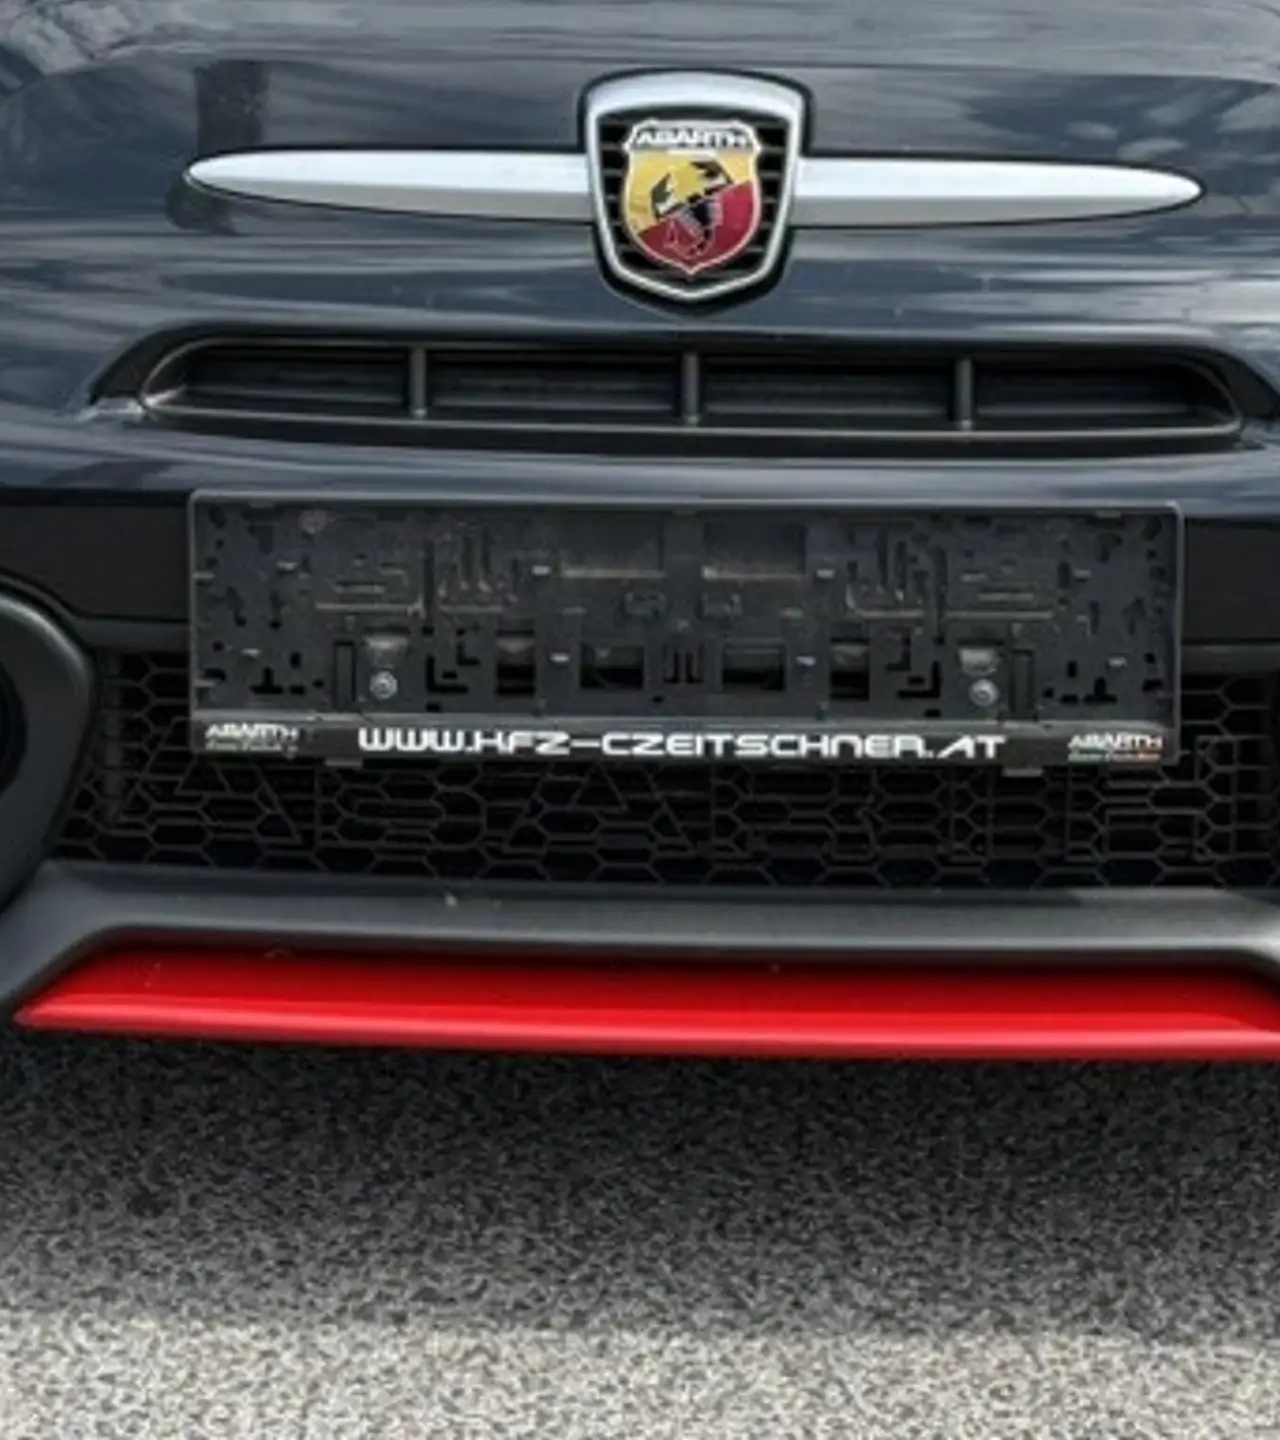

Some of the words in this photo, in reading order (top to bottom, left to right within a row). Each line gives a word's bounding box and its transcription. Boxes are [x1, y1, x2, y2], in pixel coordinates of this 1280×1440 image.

[636, 129, 748, 148] ABARTH
[204, 723, 300, 740] ABARTH
[1066, 732, 1163, 751] ABARTH
